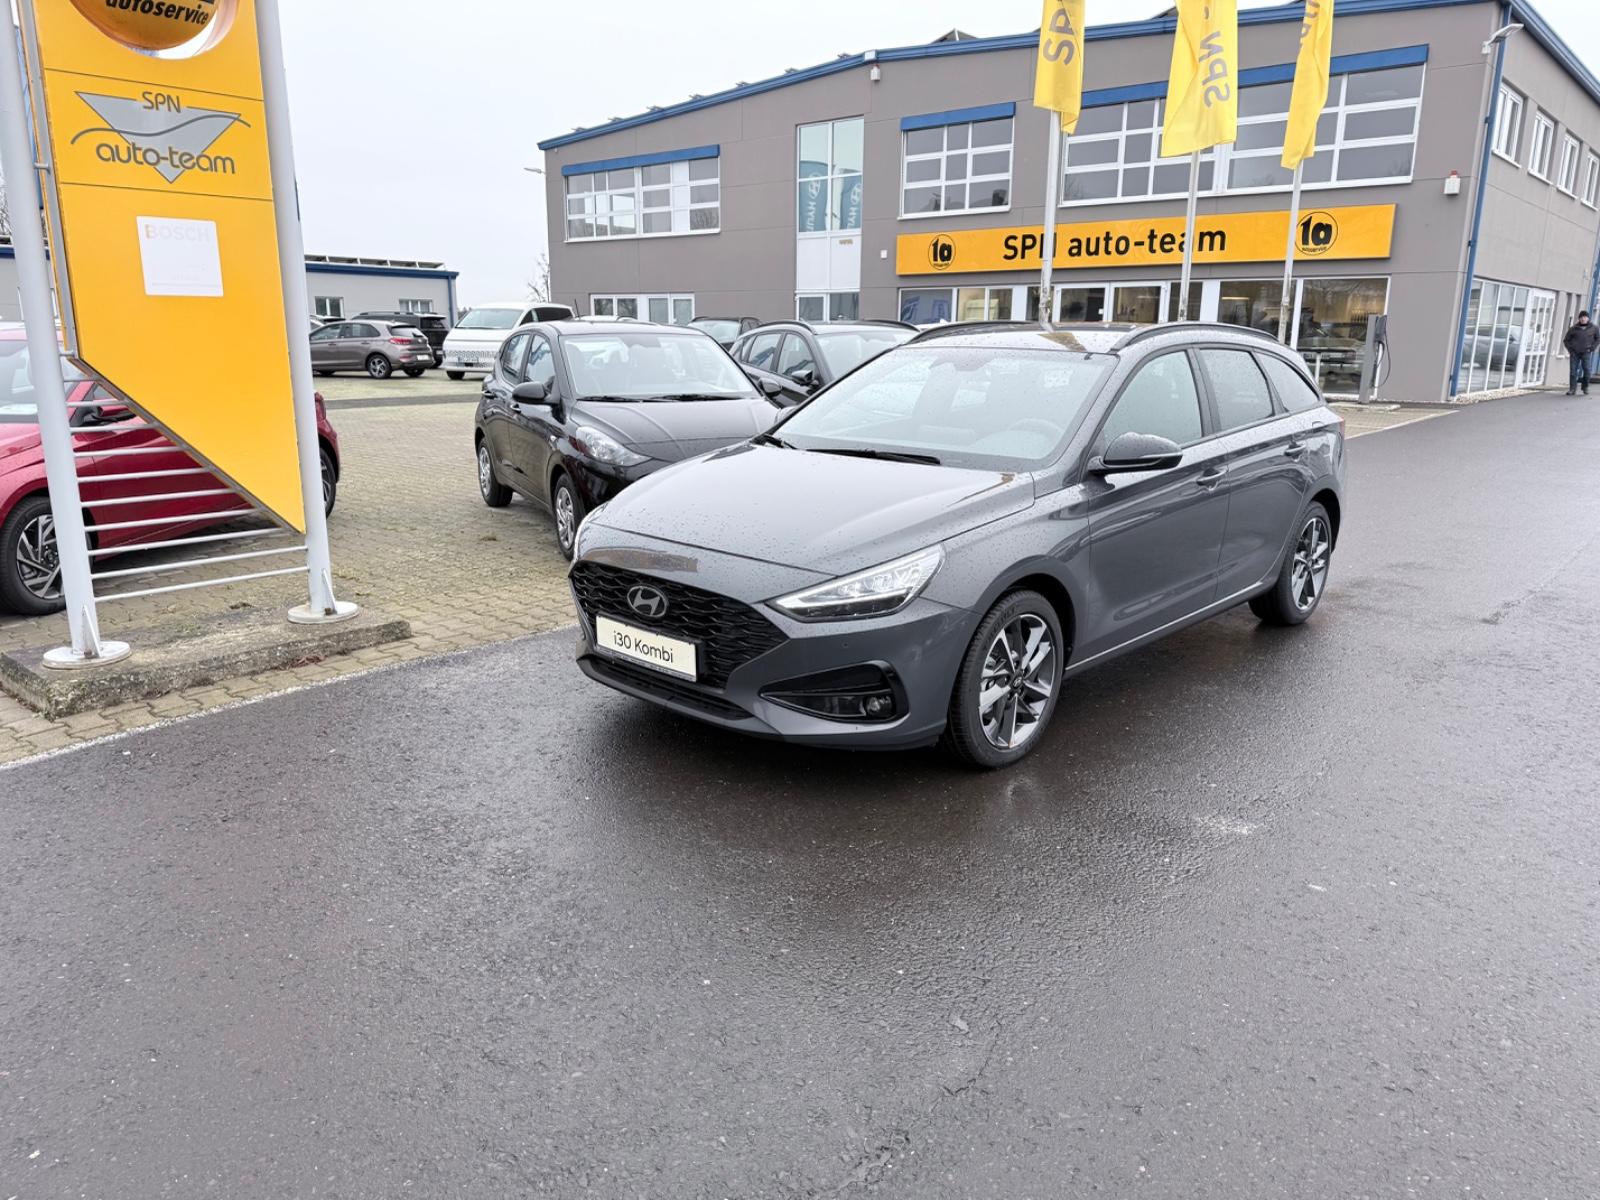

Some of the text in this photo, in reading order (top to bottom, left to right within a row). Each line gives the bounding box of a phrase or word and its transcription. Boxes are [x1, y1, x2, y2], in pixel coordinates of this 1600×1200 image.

[142, 91, 181, 113] SPN
[96, 141, 235, 174] auto-team
[144, 223, 210, 242] BOSCH
[1301, 215, 1333, 246] 1a
[613, 630, 673, 663] i30 Kombi
